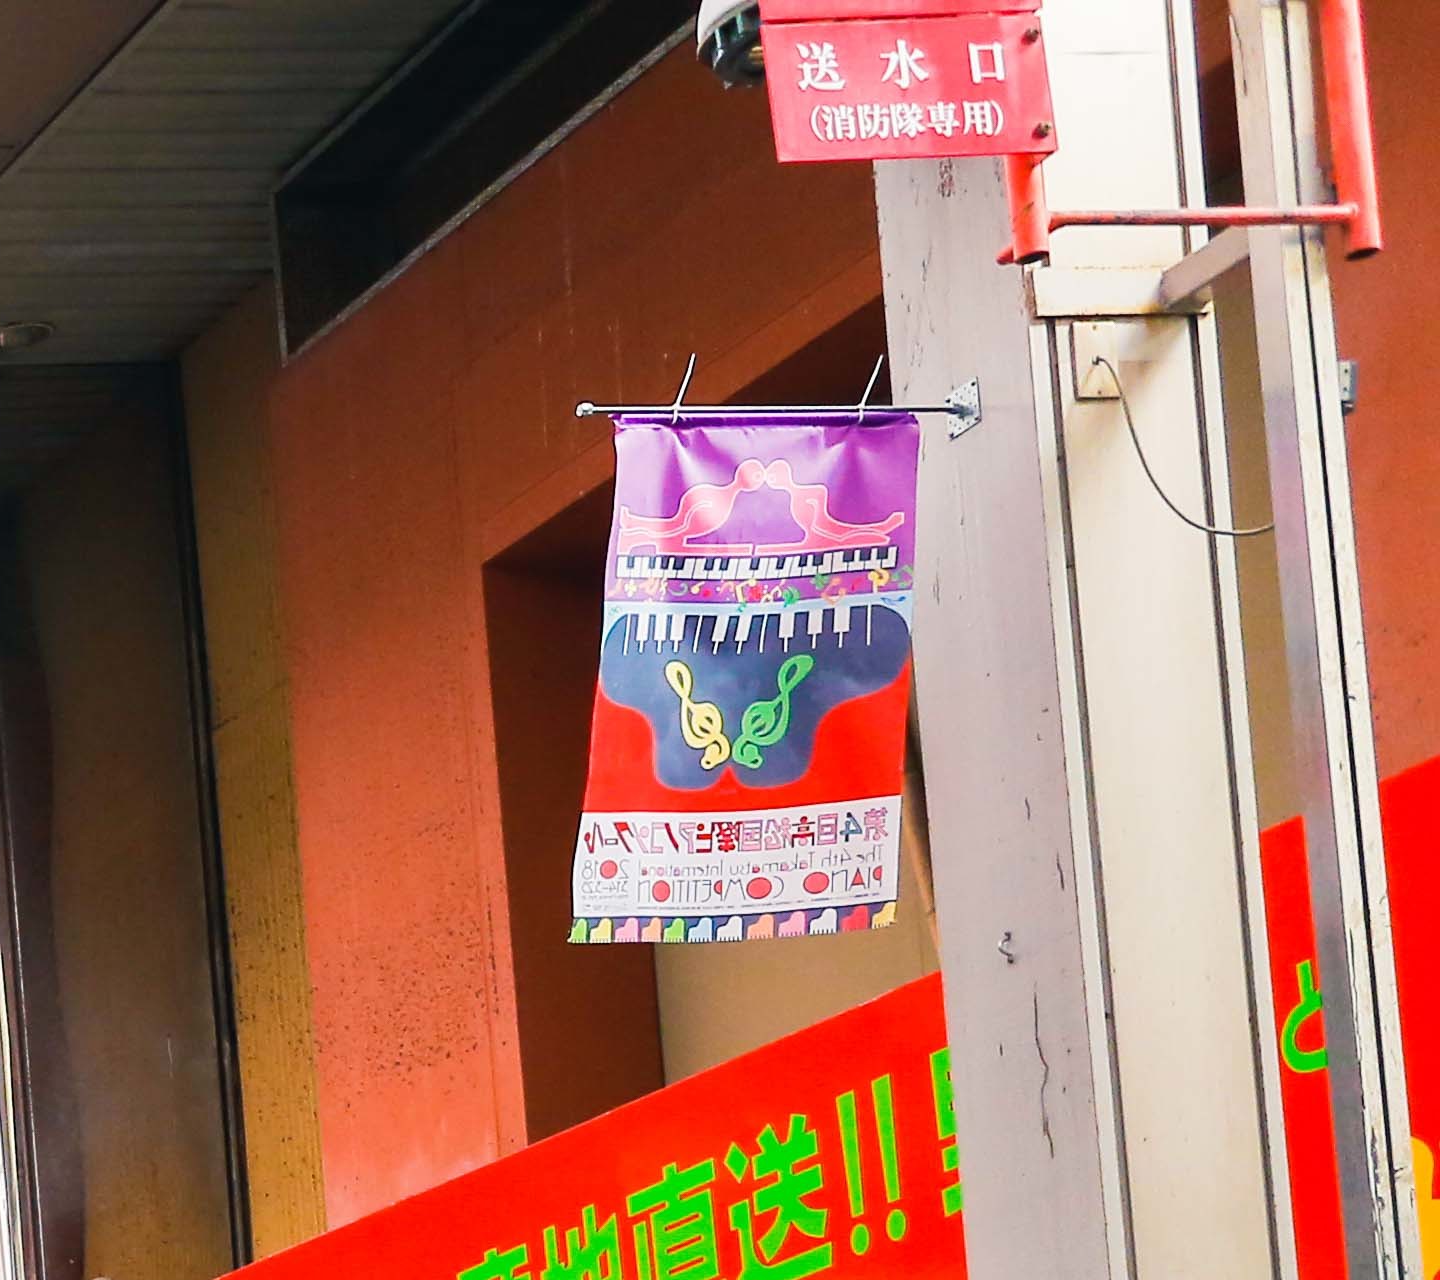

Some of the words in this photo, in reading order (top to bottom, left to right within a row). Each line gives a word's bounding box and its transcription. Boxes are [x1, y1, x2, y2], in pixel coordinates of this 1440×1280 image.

[797, 41, 1007, 92] 送水口
[810, 101, 1005, 142] (消防隊専用)
